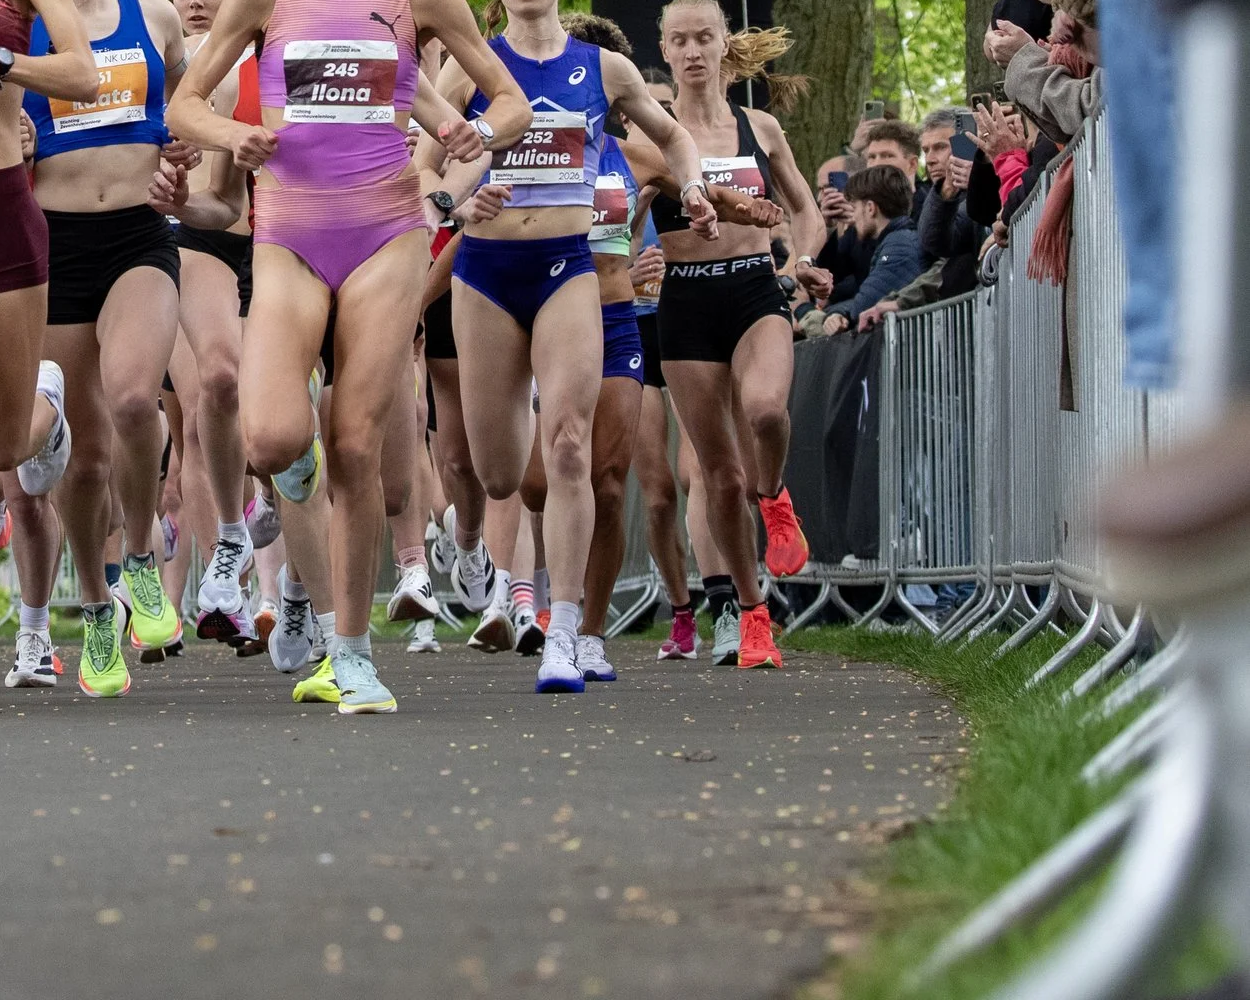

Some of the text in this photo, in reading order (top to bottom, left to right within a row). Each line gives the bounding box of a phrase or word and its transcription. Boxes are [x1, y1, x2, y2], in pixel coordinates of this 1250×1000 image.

[104, 54, 117, 63] NK
[323, 63, 359, 77] 245
[311, 84, 371, 102] Ilona
[364, 110, 391, 119] 2026
[522, 131, 554, 144] 252
[503, 148, 571, 167] Juliane
[559, 172, 580, 180] 2026
[708, 172, 733, 184] 249
[670, 262, 727, 277] NIKE
